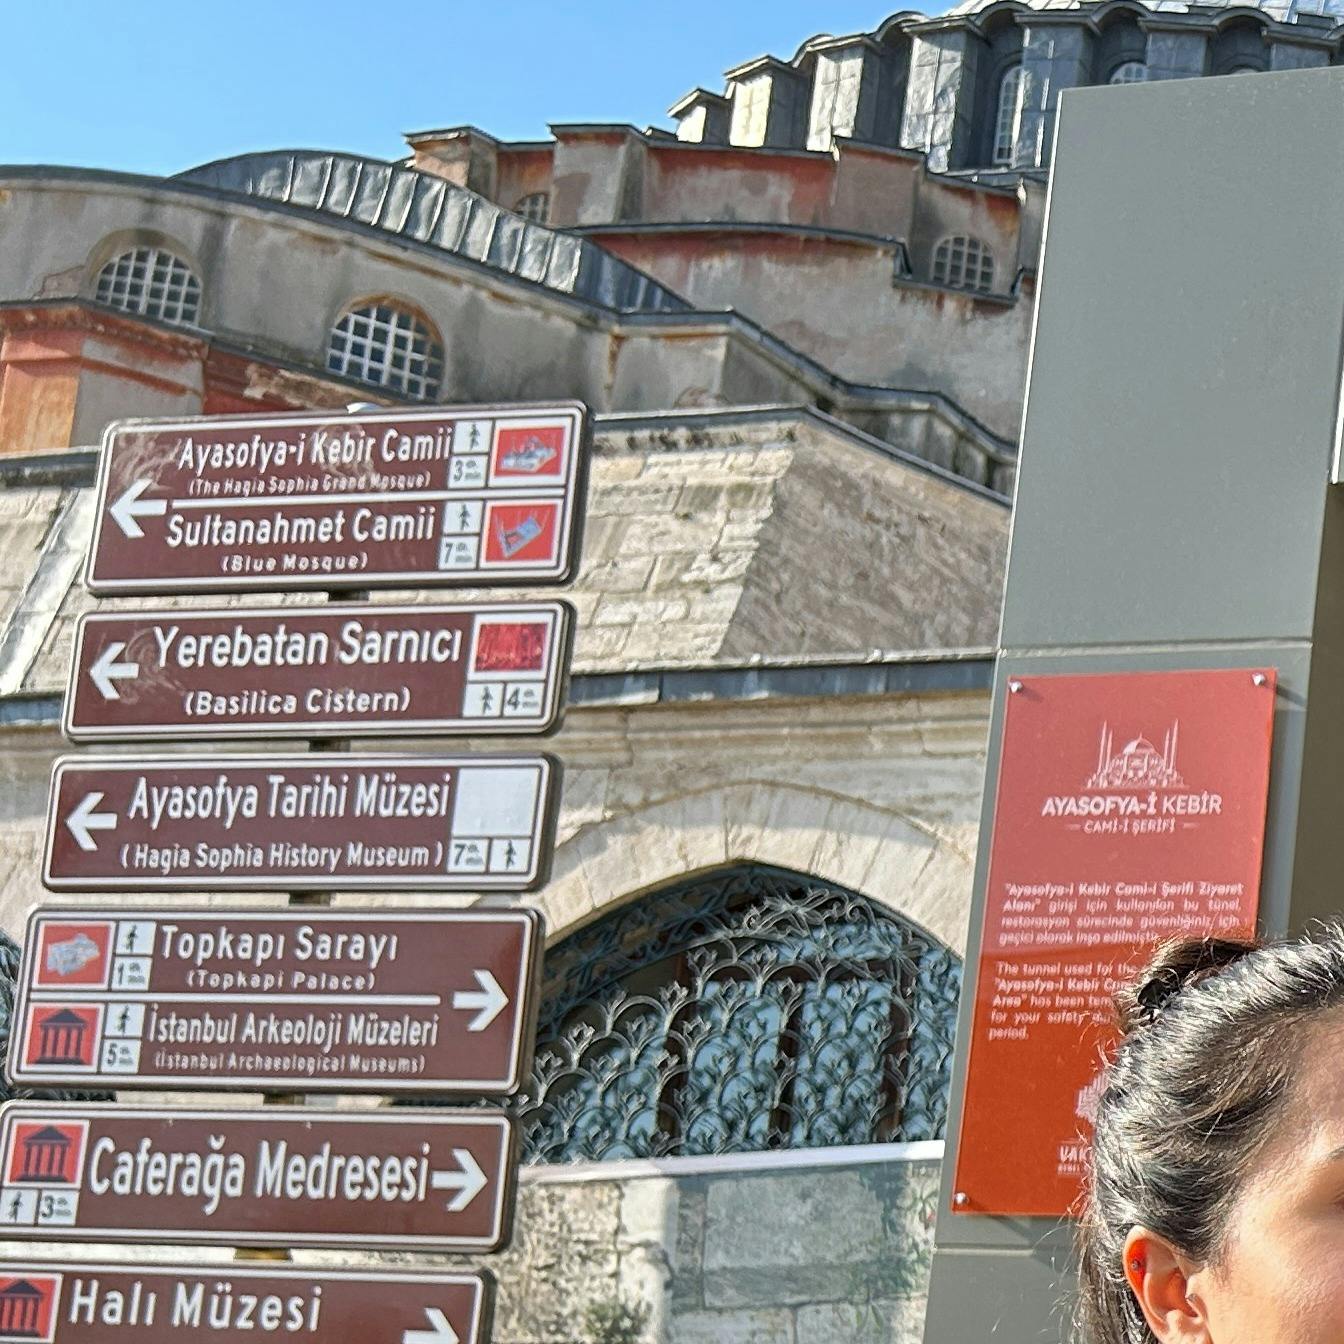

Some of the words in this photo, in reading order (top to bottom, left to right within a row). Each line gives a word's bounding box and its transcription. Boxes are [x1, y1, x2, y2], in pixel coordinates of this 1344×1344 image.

[178, 432, 306, 477] Ayasofya-i
[311, 430, 377, 465] Kebir
[381, 427, 452, 464] Camii
[165, 509, 347, 548] Sultanahmet
[352, 506, 437, 543] Camii
[220, 554, 277, 573] (Blue
[281, 551, 369, 573] Mosque)
[153, 623, 330, 669] Yerebatan
[337, 619, 463, 666] Sarnıcı
[183, 687, 298, 717] (Basilica
[304, 685, 412, 716] Cistern)
[506, 687, 519, 712] 4
[127, 774, 259, 830] Ayasofya
[265, 773, 351, 819] Tarihi
[354, 772, 452, 818] Müzesi
[1041, 790, 1159, 817] AYASOFYA-İ
[1162, 790, 1223, 816] KEBİR
[1083, 817, 1130, 835] CAMİ-İ
[133, 842, 191, 875] Hagia
[193, 841, 264, 873] Sophia
[267, 841, 342, 873] History
[346, 841, 430, 868] Museum
[452, 843, 466, 867] 7
[1078, 881, 1112, 896] Kebir
[1198, 880, 1245, 899] Ziyaret
[1182, 897, 1200, 913] bu
[160, 924, 287, 968] Topkapı
[295, 925, 400, 971] Sarayı
[292, 970, 376, 992] Palace)
[995, 960, 1020, 976] The
[1023, 961, 1062, 977] tunnel
[1064, 961, 1094, 977] used
[1030, 993, 1052, 1008] has
[1055, 993, 1085, 1008] been
[148, 1002, 239, 1045] İstanbul
[239, 1011, 343, 1054] Arkeoloji
[346, 1010, 441, 1048] Müzeleri
[1013, 1011, 1042, 1027] your
[88, 1133, 247, 1217] Caferağa
[254, 1139, 432, 1203] Medresesi
[40, 1194, 56, 1221] 3
[68, 1277, 158, 1328] Halı
[171, 1281, 323, 1333] Müzesi
